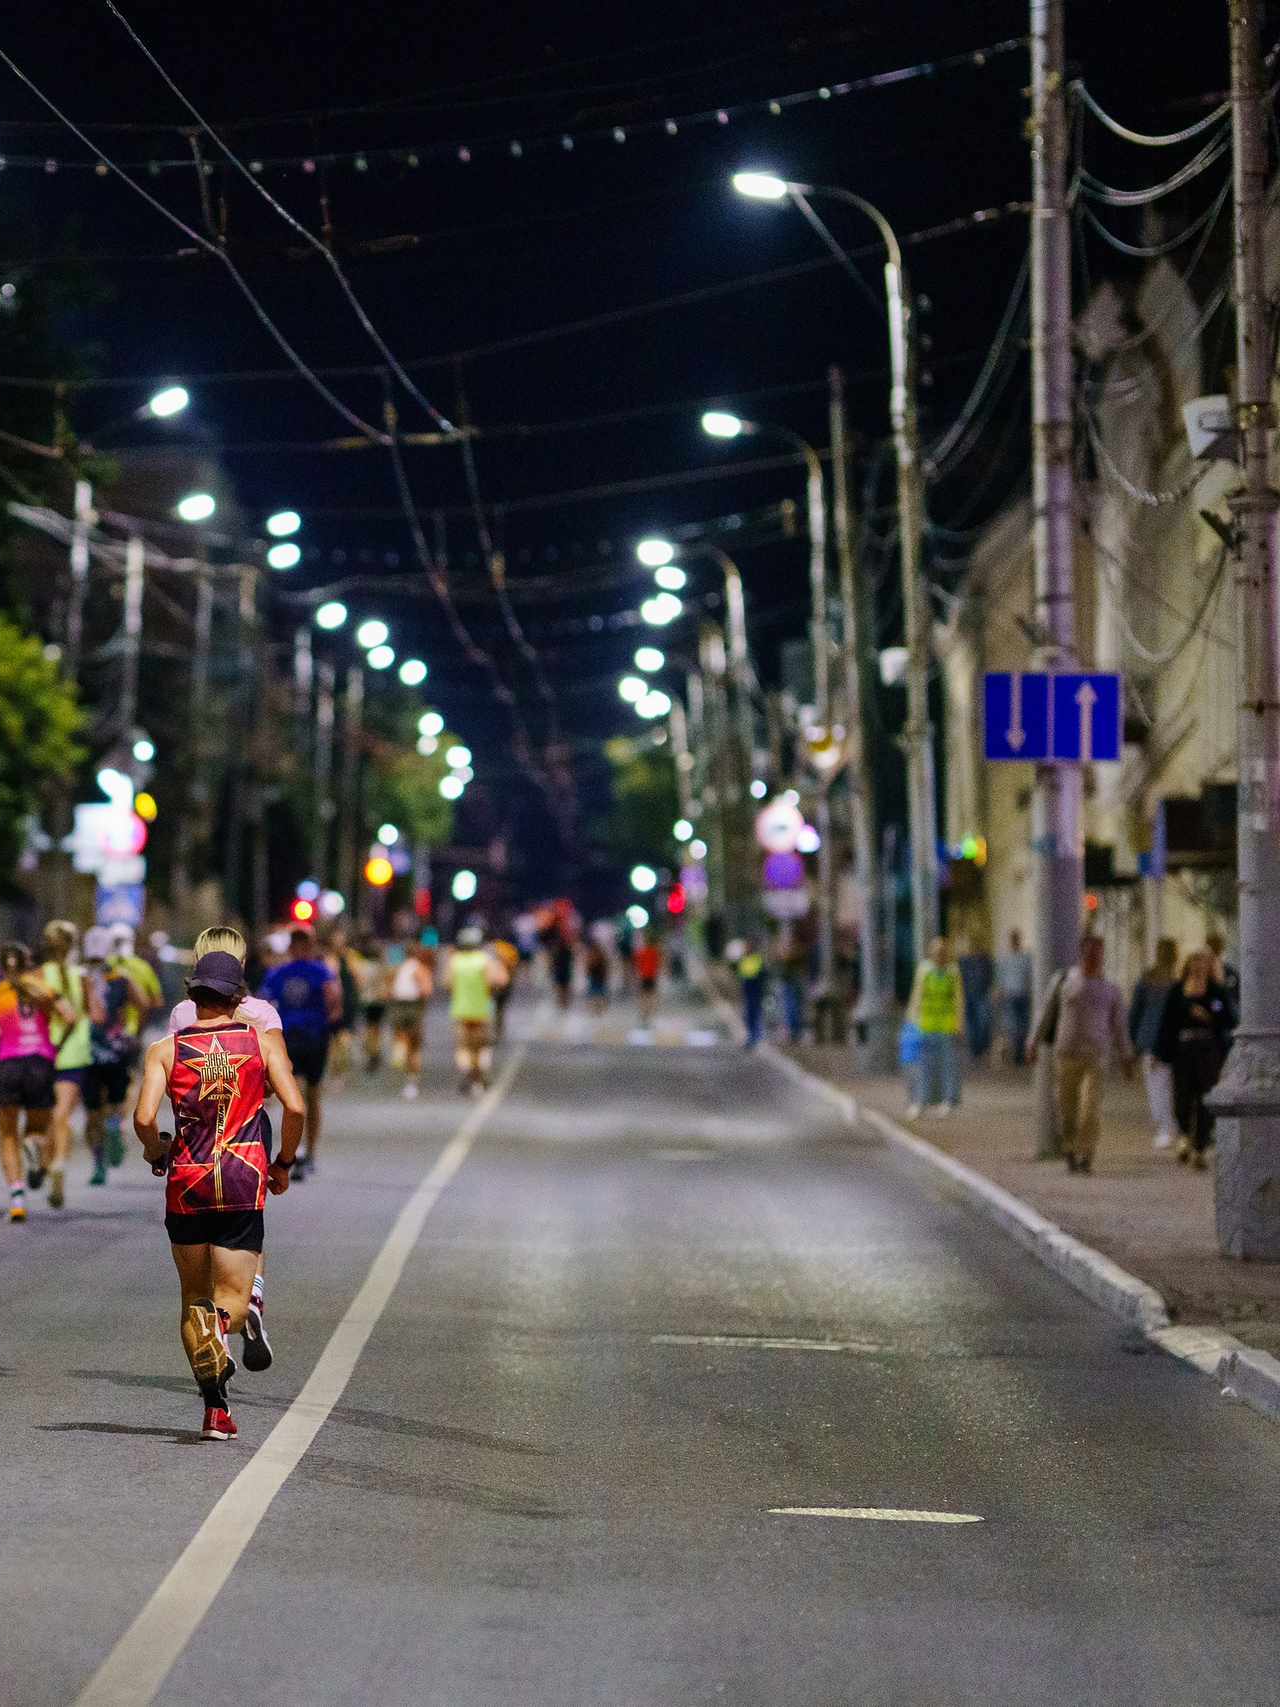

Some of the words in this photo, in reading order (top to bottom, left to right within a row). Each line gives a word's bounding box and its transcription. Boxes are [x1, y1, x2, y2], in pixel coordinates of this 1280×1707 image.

[205, 1052, 229, 1067] ЗАБЕГ
[201, 1065, 237, 1082] ПОБЕДЫ
[217, 1105, 225, 1134] WORLD
